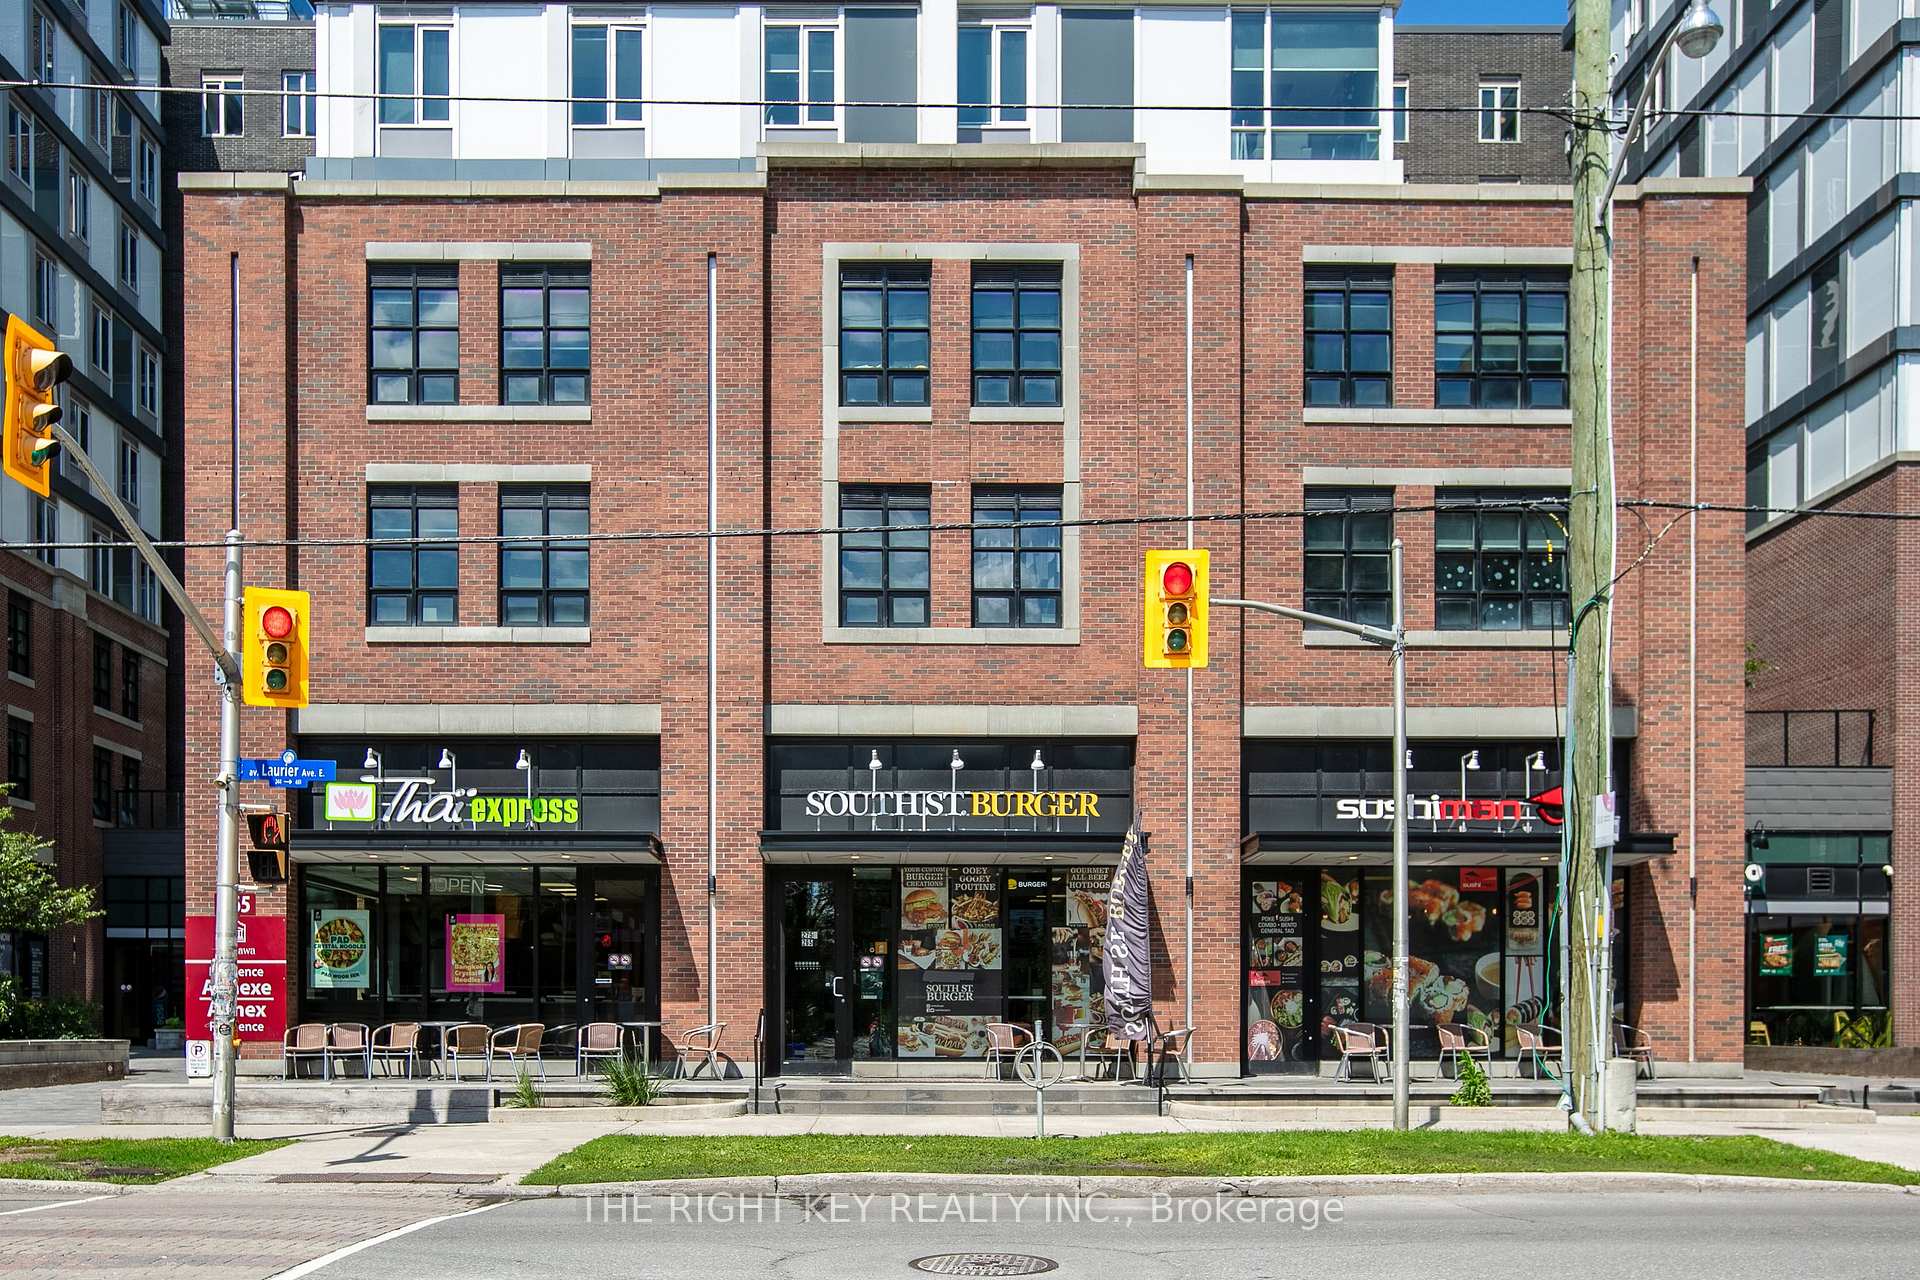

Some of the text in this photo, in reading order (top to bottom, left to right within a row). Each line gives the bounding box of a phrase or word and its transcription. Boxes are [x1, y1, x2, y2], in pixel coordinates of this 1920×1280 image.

[250, 763, 325, 778] av. Laurier Ave. E.
[971, 791, 1100, 817] BURGER
[471, 797, 579, 827] express
[955, 883, 996, 891] POUTINE
[1069, 881, 1111, 889] HOTDOGS
[330, 936, 350, 944] PAD
[202, 979, 272, 996] Aexe
[926, 984, 974, 992] SOUTH ST.
[926, 992, 975, 1001] BURGER
